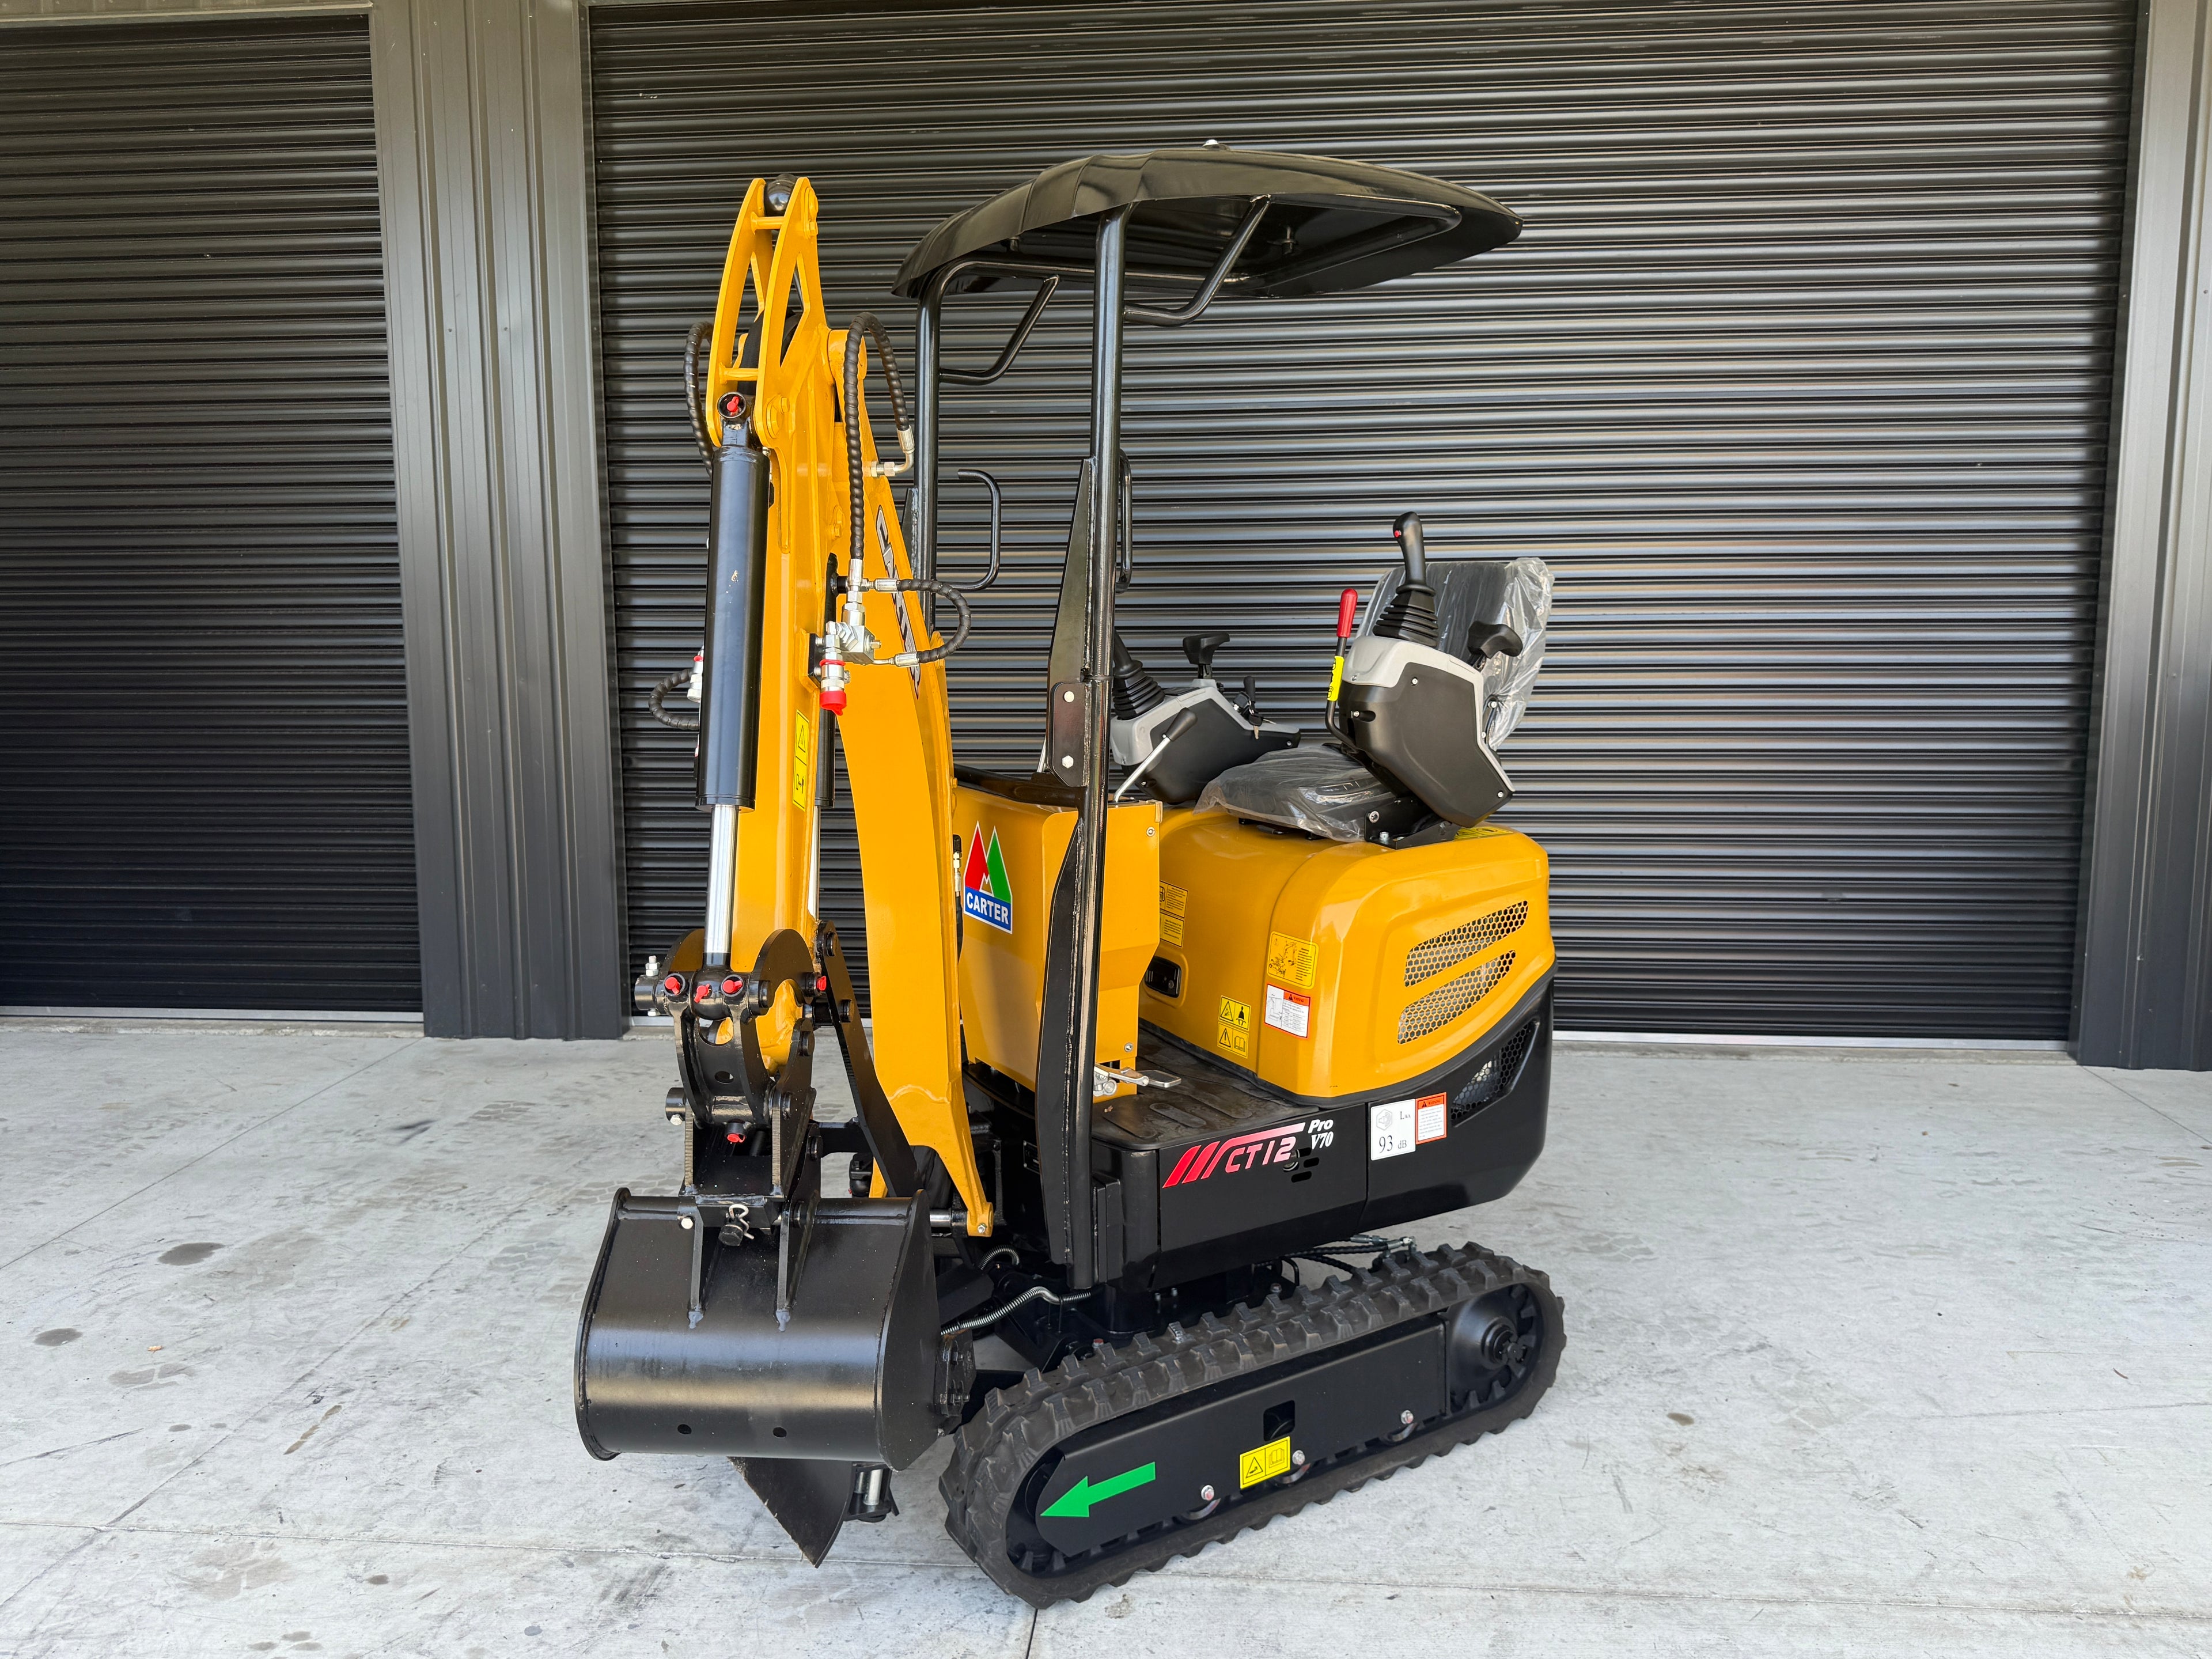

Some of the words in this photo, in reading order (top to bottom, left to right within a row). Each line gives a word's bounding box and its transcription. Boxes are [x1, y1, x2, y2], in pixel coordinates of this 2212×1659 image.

[876, 505, 921, 699] CARTER
[967, 892, 1009, 925] CARTER
[1308, 1119, 1334, 1133] Pro
[1311, 1131, 1334, 1150] V70
[1379, 1135, 1393, 1153] 93
[1398, 1139, 1407, 1149] dB
[1225, 1137, 1296, 1173] CT12
